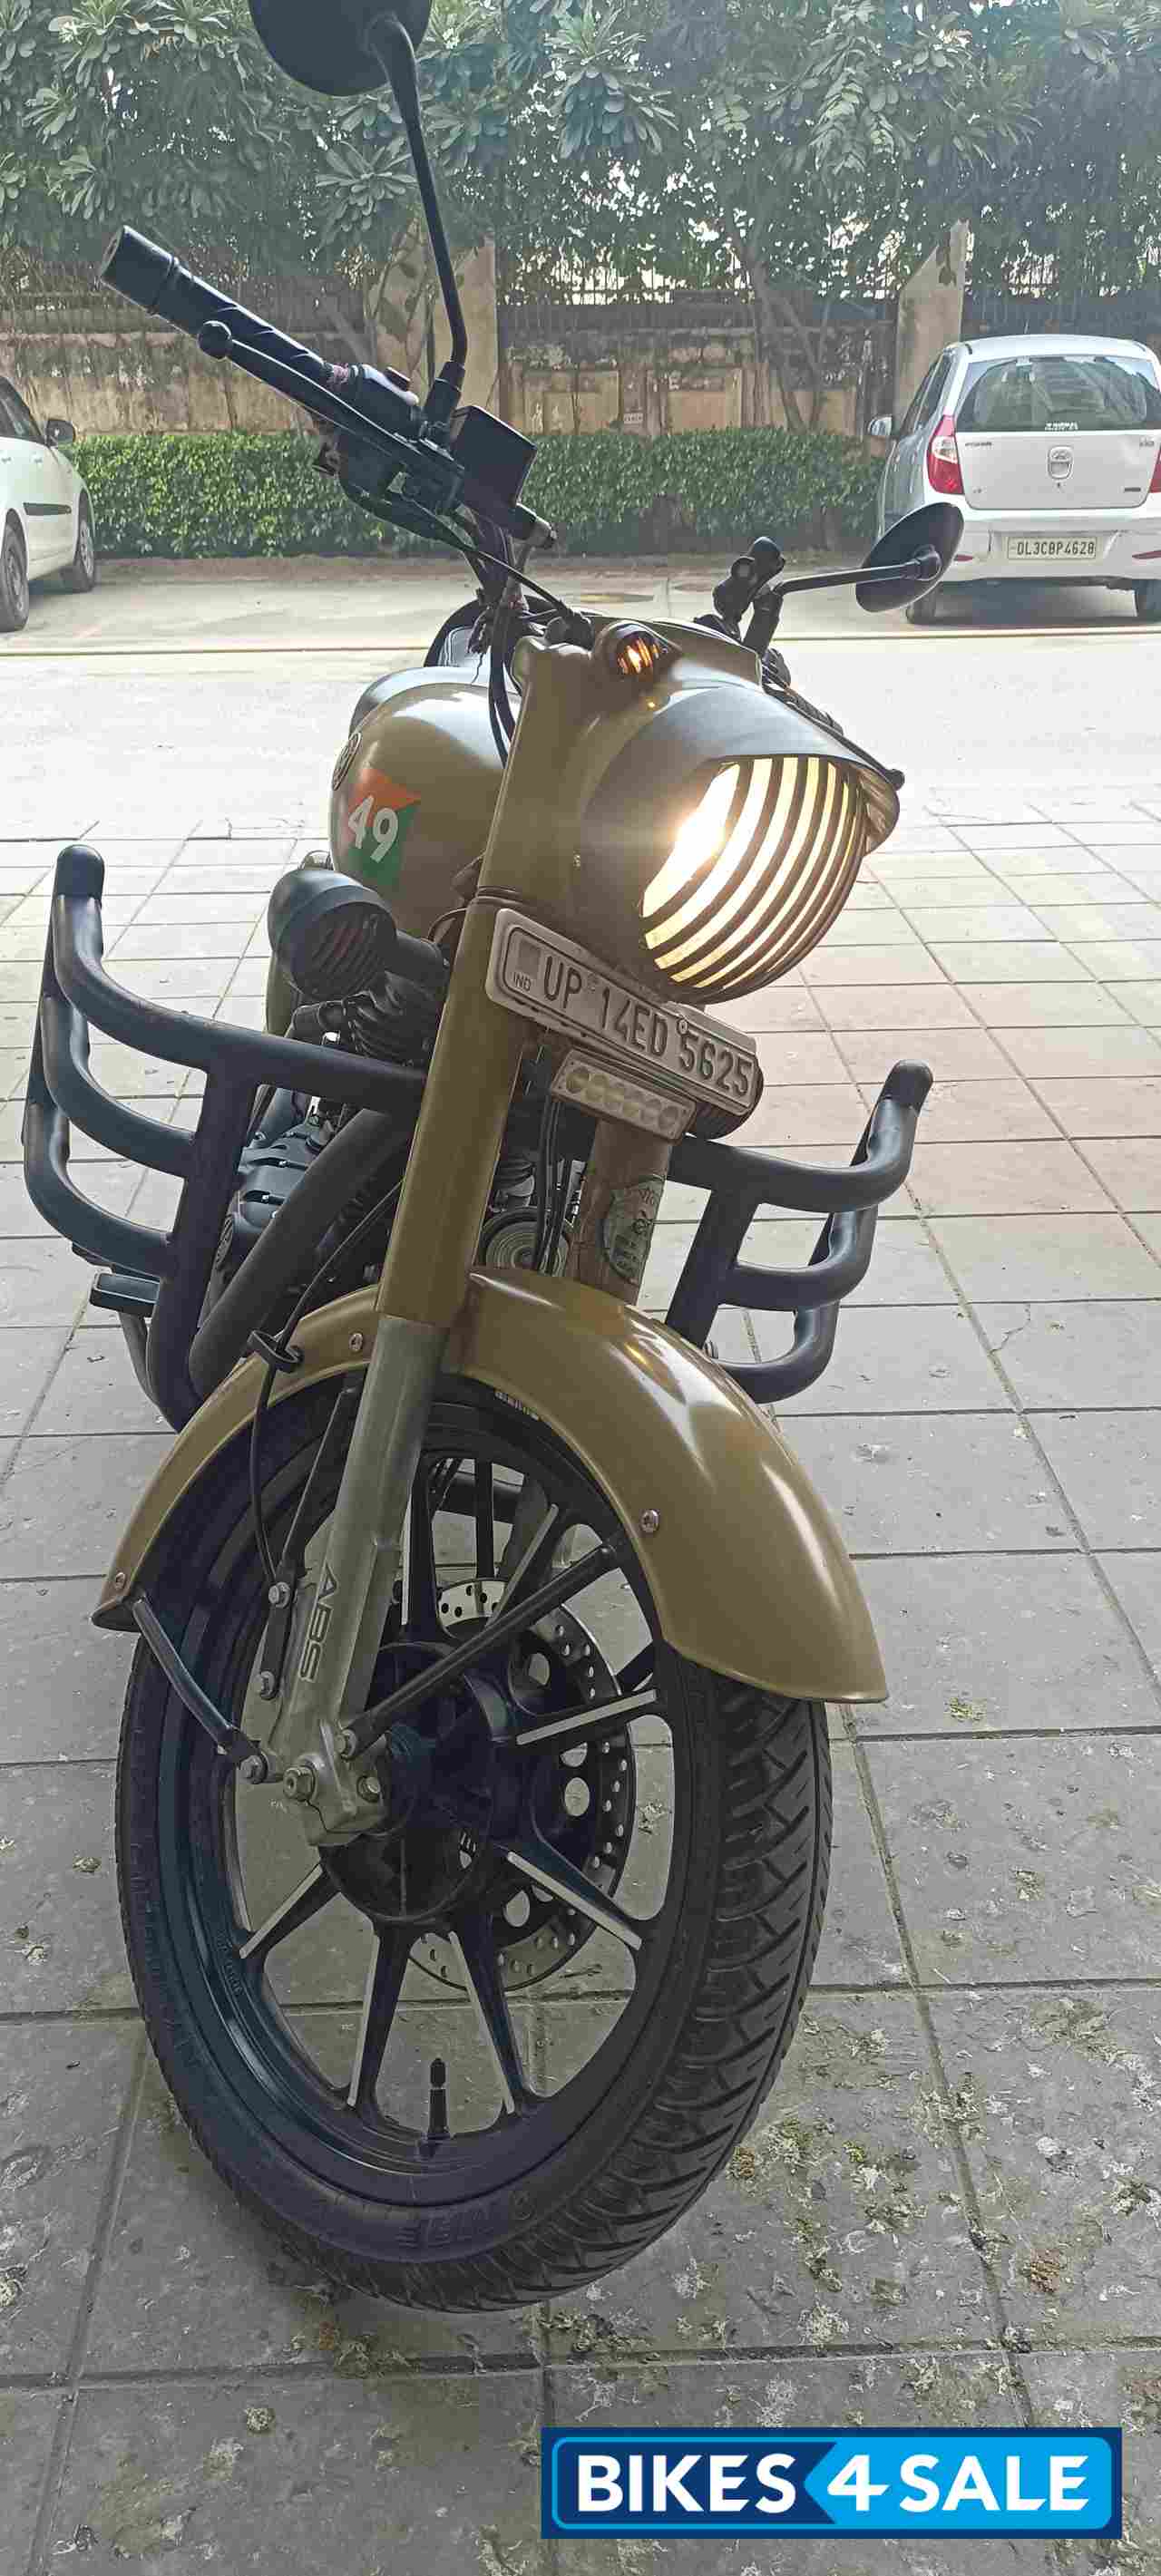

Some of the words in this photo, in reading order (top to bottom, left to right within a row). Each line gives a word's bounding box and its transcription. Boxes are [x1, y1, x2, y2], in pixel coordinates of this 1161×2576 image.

[347, 794, 399, 863] 49
[512, 973, 533, 992] IND
[544, 955, 583, 1009] UP
[600, 987, 669, 1057] 14ED
[678, 1032, 753, 1097] 5625
[299, 1563, 337, 1683] ABS
